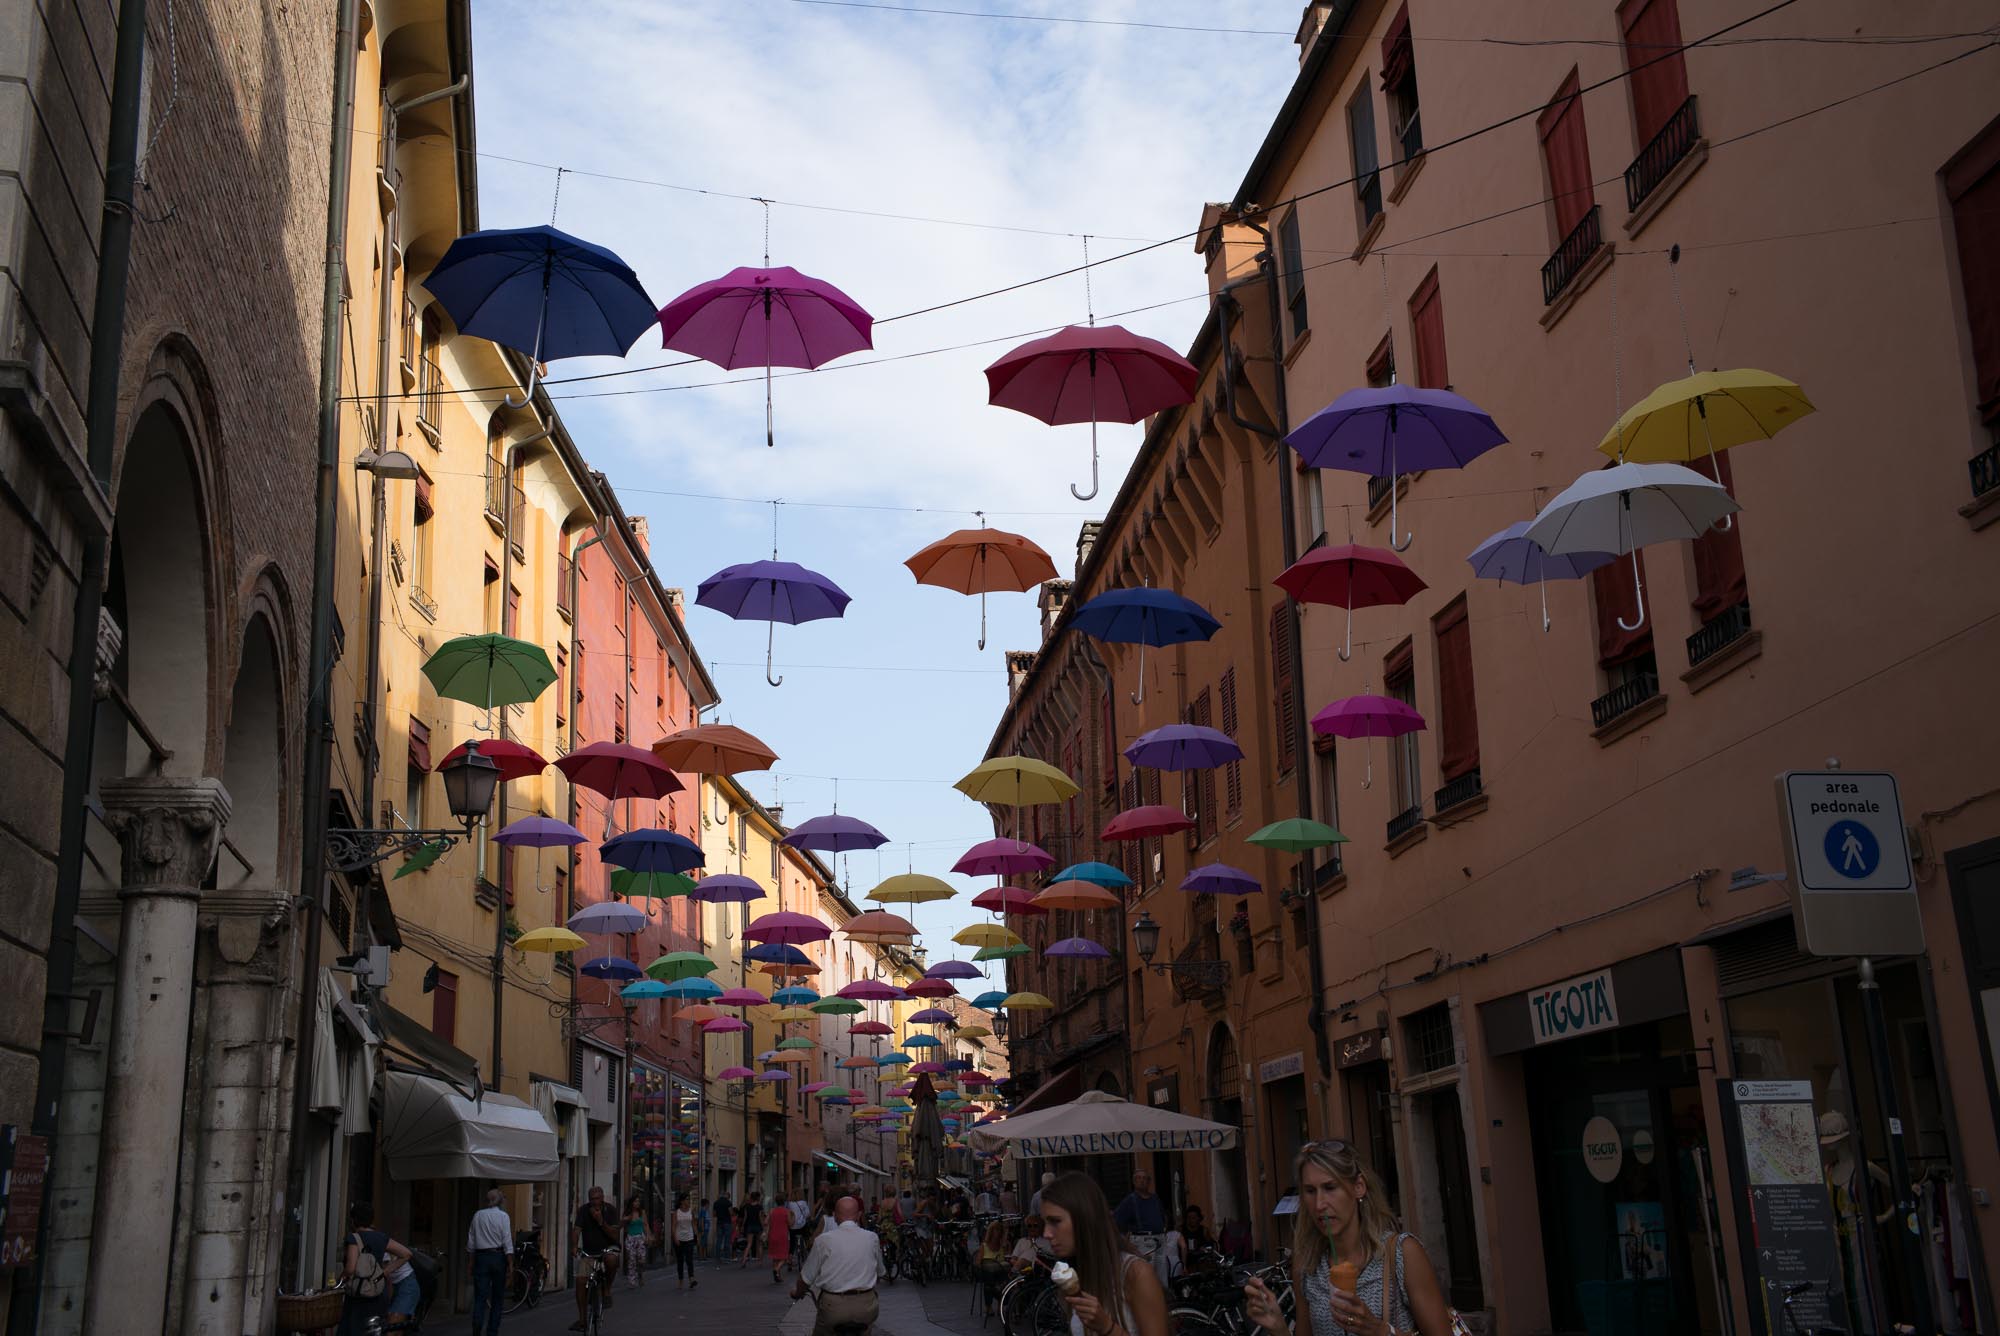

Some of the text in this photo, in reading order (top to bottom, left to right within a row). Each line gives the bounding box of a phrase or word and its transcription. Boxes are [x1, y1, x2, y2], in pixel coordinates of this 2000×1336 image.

[1826, 783, 1859, 793] area
[1811, 800, 1880, 815] pedonale
[1020, 1129, 1225, 1158] RIVARENO GELATO
